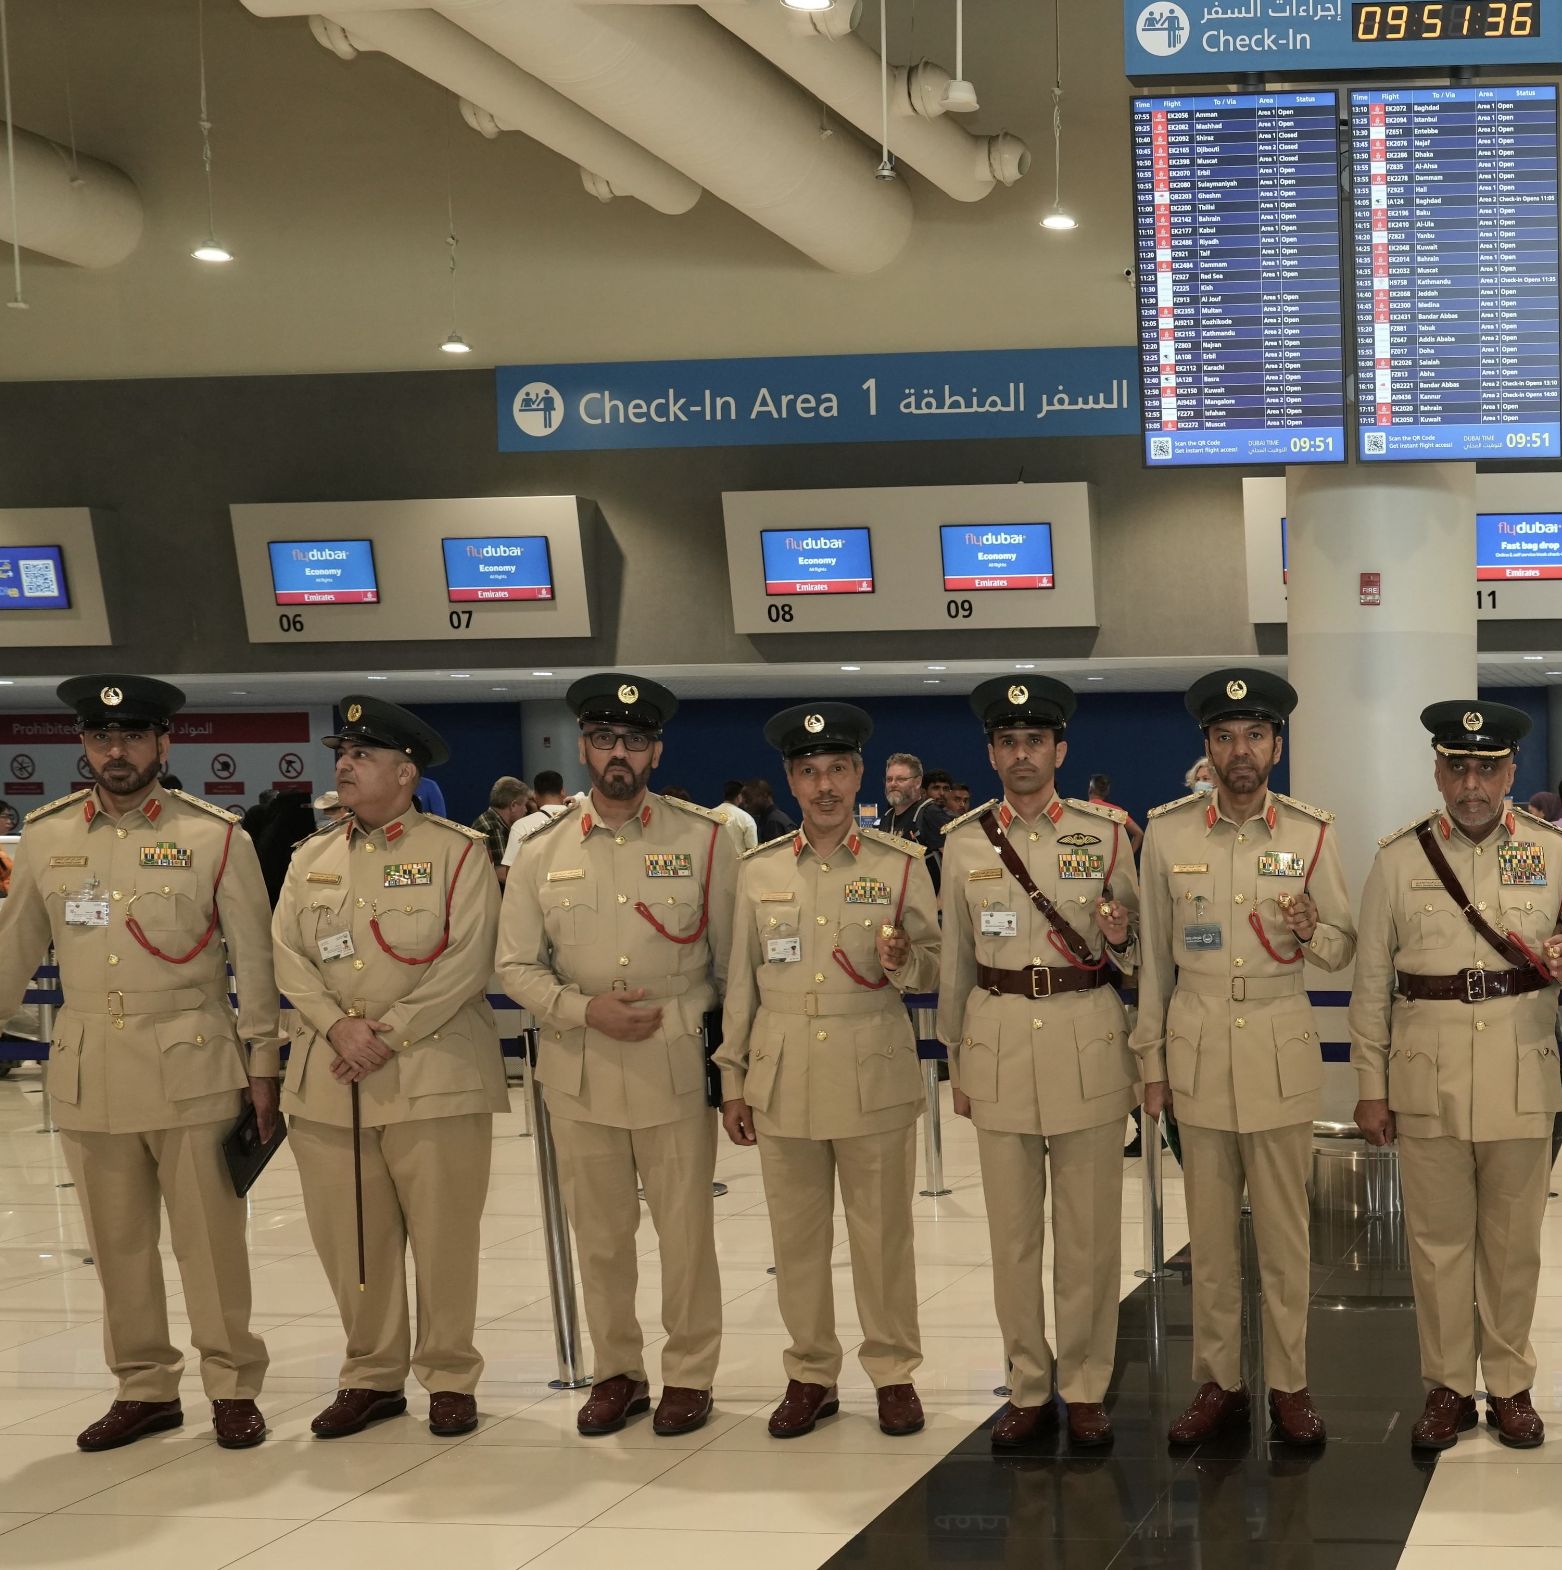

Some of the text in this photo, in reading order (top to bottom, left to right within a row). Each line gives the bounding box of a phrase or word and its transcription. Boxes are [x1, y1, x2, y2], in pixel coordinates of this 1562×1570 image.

[1201, 0, 1260, 23] السفر
[1358, 4, 1532, 40] 09:51:36
[1202, 29, 1310, 53] Check-In
[1197, 146, 1219, 154] Djibouti
[579, 378, 877, 425] Check-In Area 1
[900, 379, 1128, 418] السفر المنطقة
[1290, 437, 1333, 452] 09:51
[1507, 433, 1550, 447] 09:51
[1498, 522, 1559, 535] flydubai
[785, 537, 843, 551] flydubai
[965, 533, 1024, 546] flydubai
[1501, 542, 1560, 551] Fast bag drop
[292, 549, 348, 561] flydubai
[467, 545, 522, 558] flydubai
[978, 553, 1016, 561] Economy
[798, 557, 836, 565] Economy
[305, 568, 341, 576] Economy
[1477, 591, 1496, 609] 11
[768, 604, 793, 622] 08
[947, 600, 972, 618] 09
[280, 614, 303, 632] 06
[449, 611, 472, 628] 07
